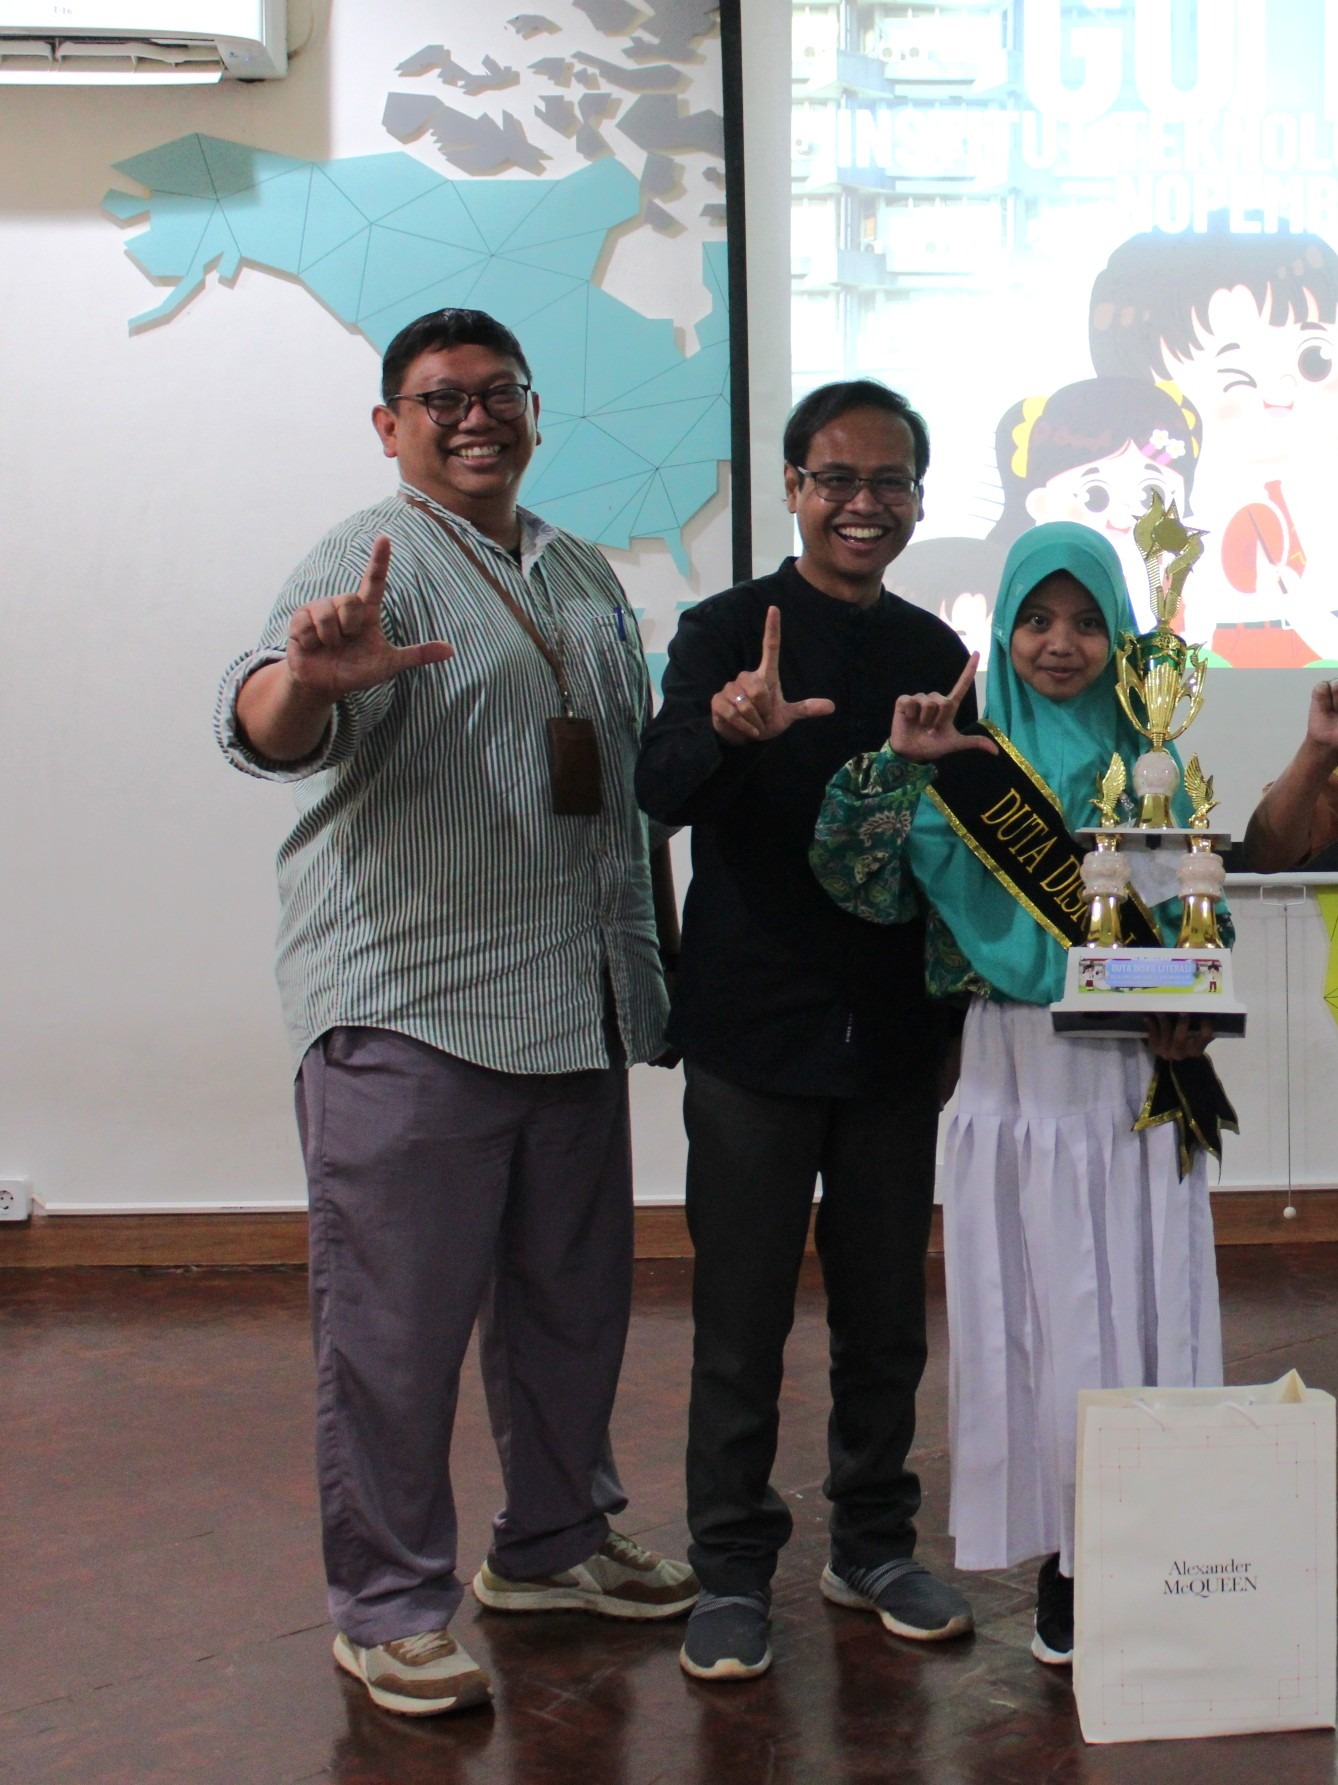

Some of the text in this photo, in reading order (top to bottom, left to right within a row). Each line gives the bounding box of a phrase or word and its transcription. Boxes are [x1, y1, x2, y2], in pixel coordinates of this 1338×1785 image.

[838, 109, 1086, 169] INSTITUT
[980, 787, 1058, 873] DUTA
[1158, 964, 1192, 973] LITERASI
[1168, 1558, 1252, 1576] Alexander
[1163, 1575, 1258, 1598] McQUEEN
